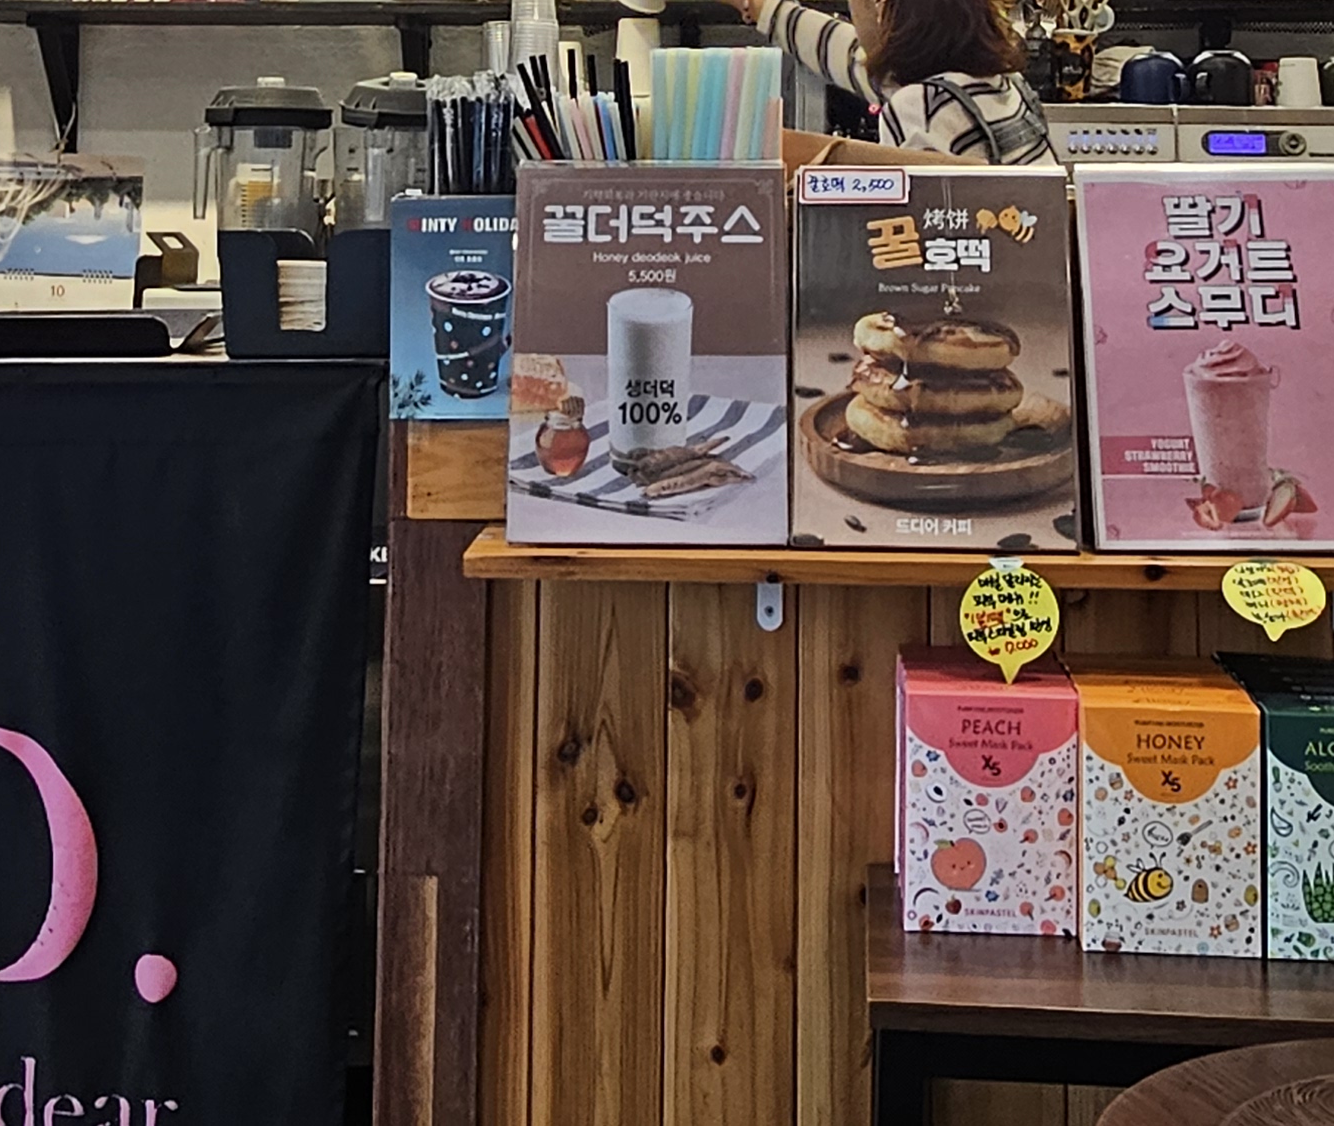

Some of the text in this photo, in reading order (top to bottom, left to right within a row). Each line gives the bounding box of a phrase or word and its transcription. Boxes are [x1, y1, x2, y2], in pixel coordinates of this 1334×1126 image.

[542, 203, 764, 244] 꿀더덕주스
[922, 206, 970, 231] 烤饼
[1162, 193, 1265, 239] 딸기
[462, 217, 519, 232] OLIDA
[866, 214, 992, 273] 꿀 호떡
[592, 251, 629, 264] Honey
[683, 252, 712, 264] juice
[1143, 238, 1298, 282] 요거트
[50, 285, 65, 297] 10
[878, 283, 910, 294] Brown
[911, 283, 939, 295] Sugar
[1146, 284, 1300, 330] 스무디
[624, 379, 676, 399] 생더덕
[617, 402, 683, 425] 100%
[1150, 438, 1191, 450] YOGURT
[1124, 449, 1194, 462] STRAWBERRY
[1142, 460, 1197, 473] SMOOTHIE
[894, 518, 973, 535] 드디어 커피
[960, 719, 1022, 736] PEACH
[948, 739, 980, 751] Sweet
[1010, 740, 1034, 751] Pack
[1135, 733, 1206, 751] HONEY
[1127, 752, 1215, 767] Sweet Mask Pack
[964, 908, 1018, 918] SKINPASTEL
[1144, 926, 1199, 938] SKINPASTEL
